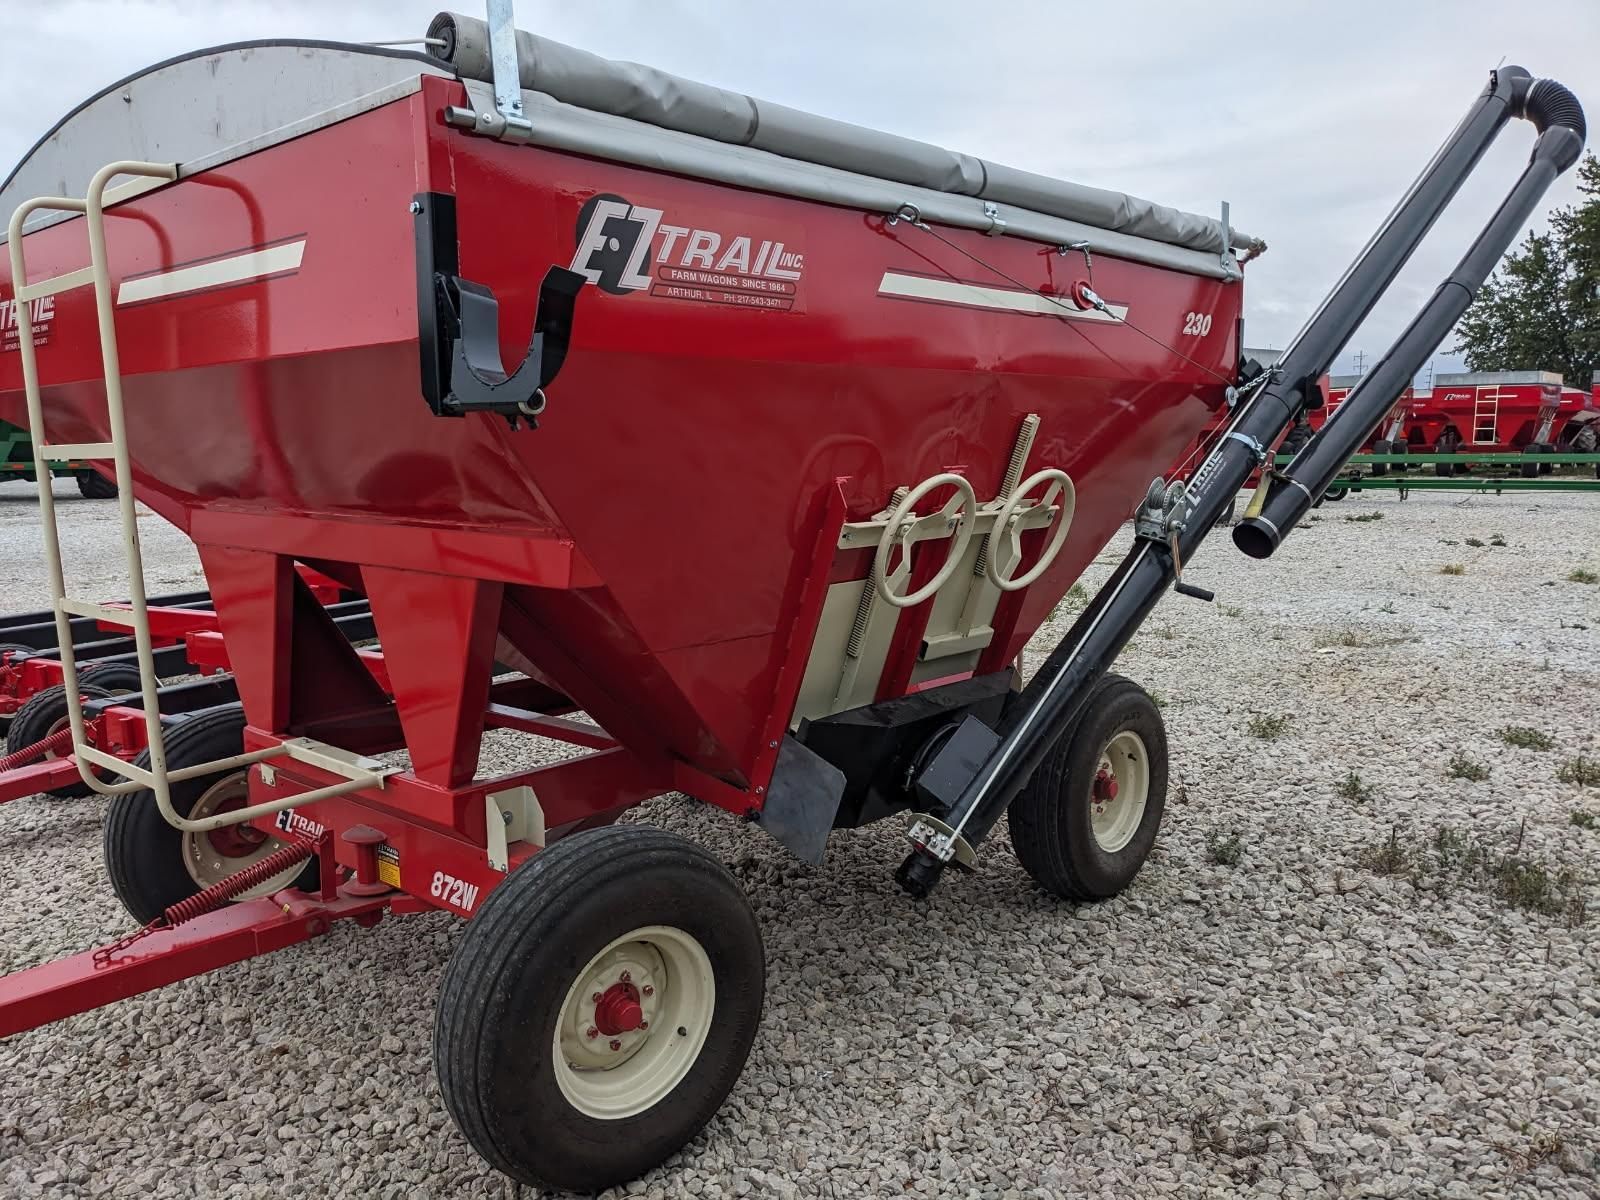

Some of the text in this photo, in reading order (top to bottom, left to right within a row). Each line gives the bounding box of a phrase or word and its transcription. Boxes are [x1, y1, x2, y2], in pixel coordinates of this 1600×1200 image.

[656, 224, 802, 281] TRAIL
[779, 251, 804, 269] INC.
[671, 269, 697, 281] FARM
[699, 273, 738, 286] WAGONS
[742, 279, 767, 290] SINCE
[1182, 311, 1212, 337] 230
[430, 871, 479, 912] 872W
